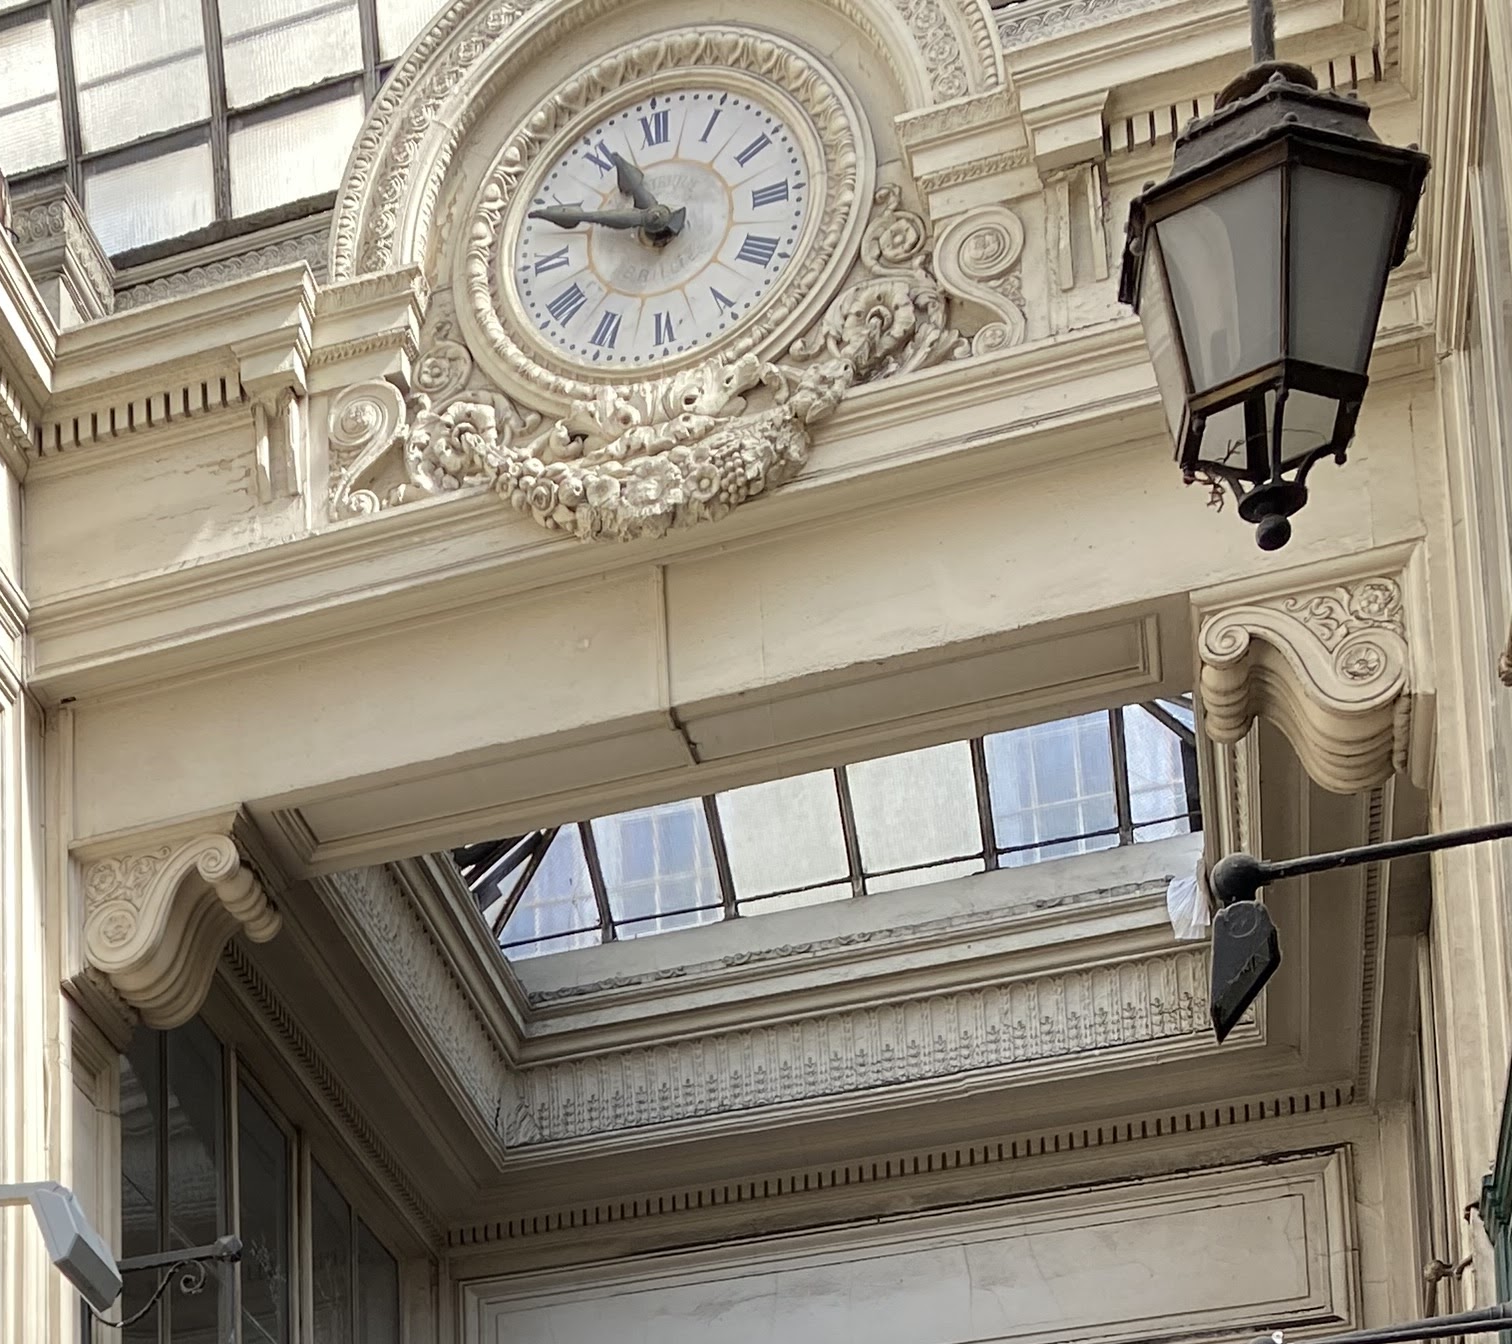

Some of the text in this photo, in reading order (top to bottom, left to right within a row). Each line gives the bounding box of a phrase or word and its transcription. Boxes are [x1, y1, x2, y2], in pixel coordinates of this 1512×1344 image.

[638, 109, 671, 151] XII
[698, 108, 723, 143] I
[733, 132, 773, 168] II
[752, 178, 789, 211] III
